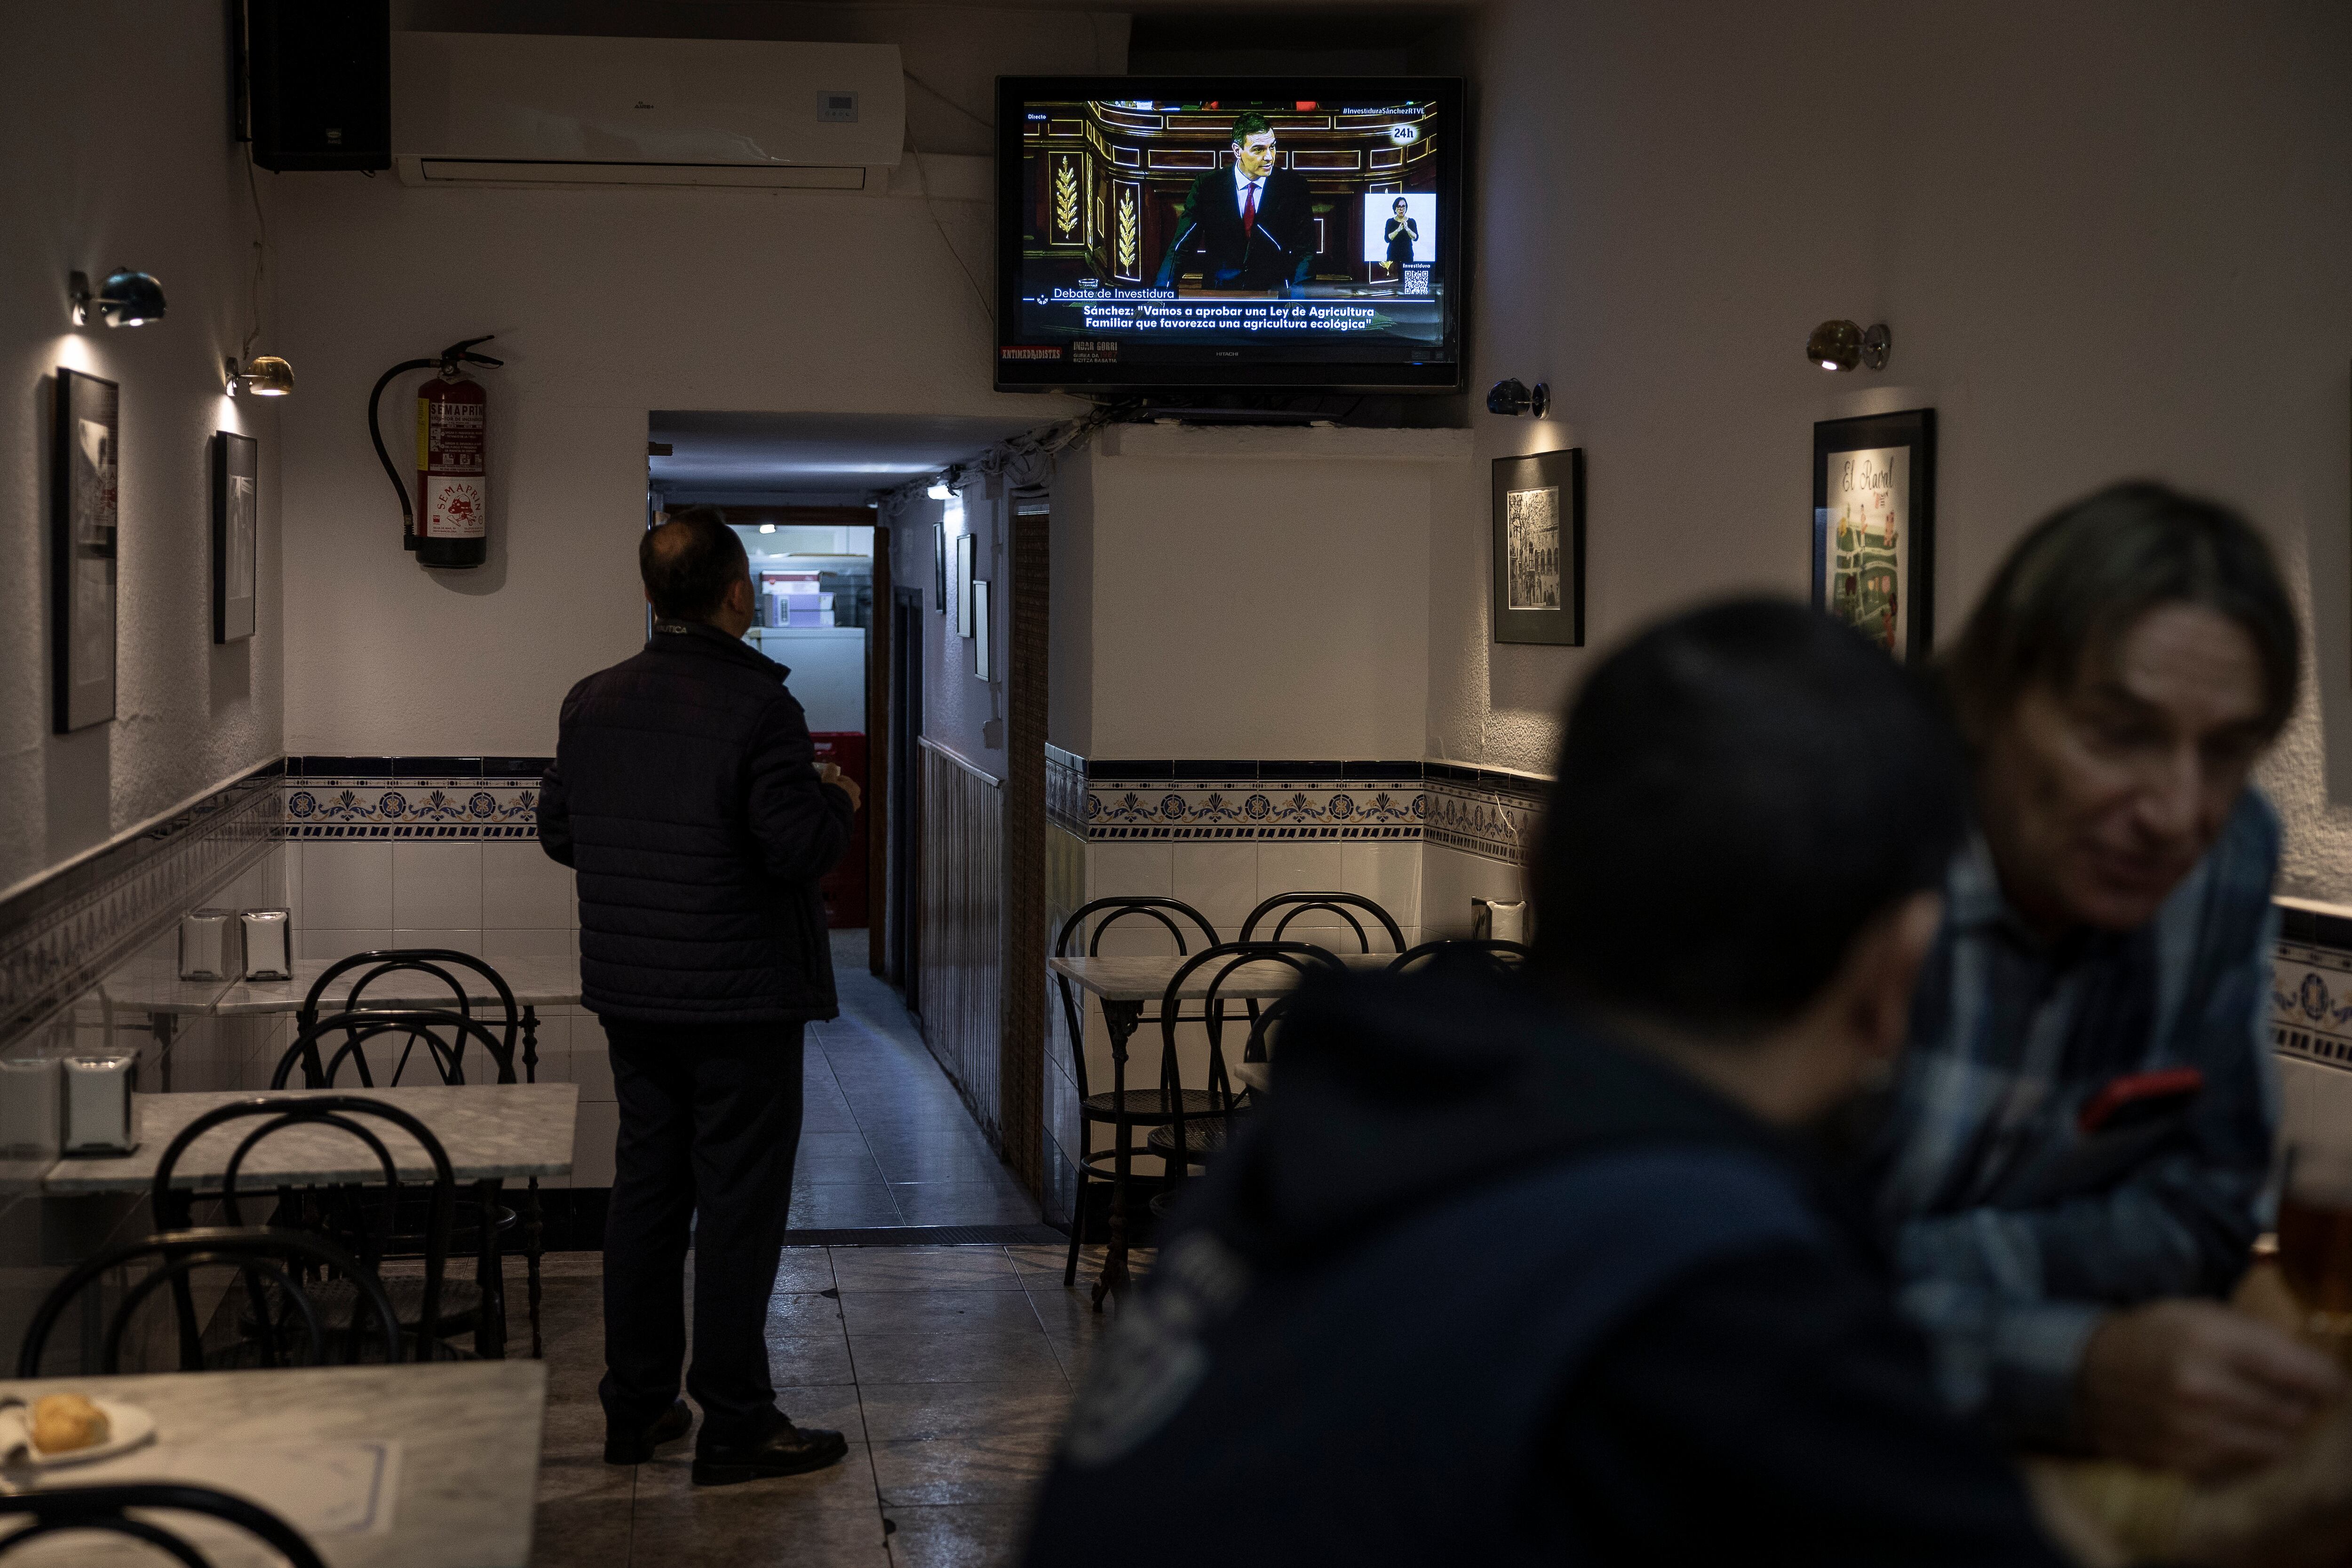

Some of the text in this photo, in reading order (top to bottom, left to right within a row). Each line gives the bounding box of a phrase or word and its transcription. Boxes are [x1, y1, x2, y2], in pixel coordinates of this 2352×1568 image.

[1394, 127, 1414, 138] 24h
[1054, 288, 1174, 298] Debate de Investidura
[1083, 305, 1134, 316] Sánchez:
[1138, 305, 1182, 316] "Vamos
[1195, 306, 1242, 318] aprobar
[1245, 308, 1267, 317] una
[1270, 307, 1289, 318] Ley
[1292, 307, 1306, 317] de
[1309, 306, 1375, 319] Agricultura
[1086, 318, 1134, 328] Familiar
[1136, 319, 1157, 330] que
[1160, 318, 1216, 328] favorezca
[1243, 319, 1307, 331] agricultura
[1310, 318, 1372, 331] ecológica"
[1073, 342, 1118, 351] INDAR GORRI
[431, 404, 483, 416] SEMAPRIN
[1843, 455, 1895, 492] El Raval
[437, 484, 481, 511] SEMAPRIN
